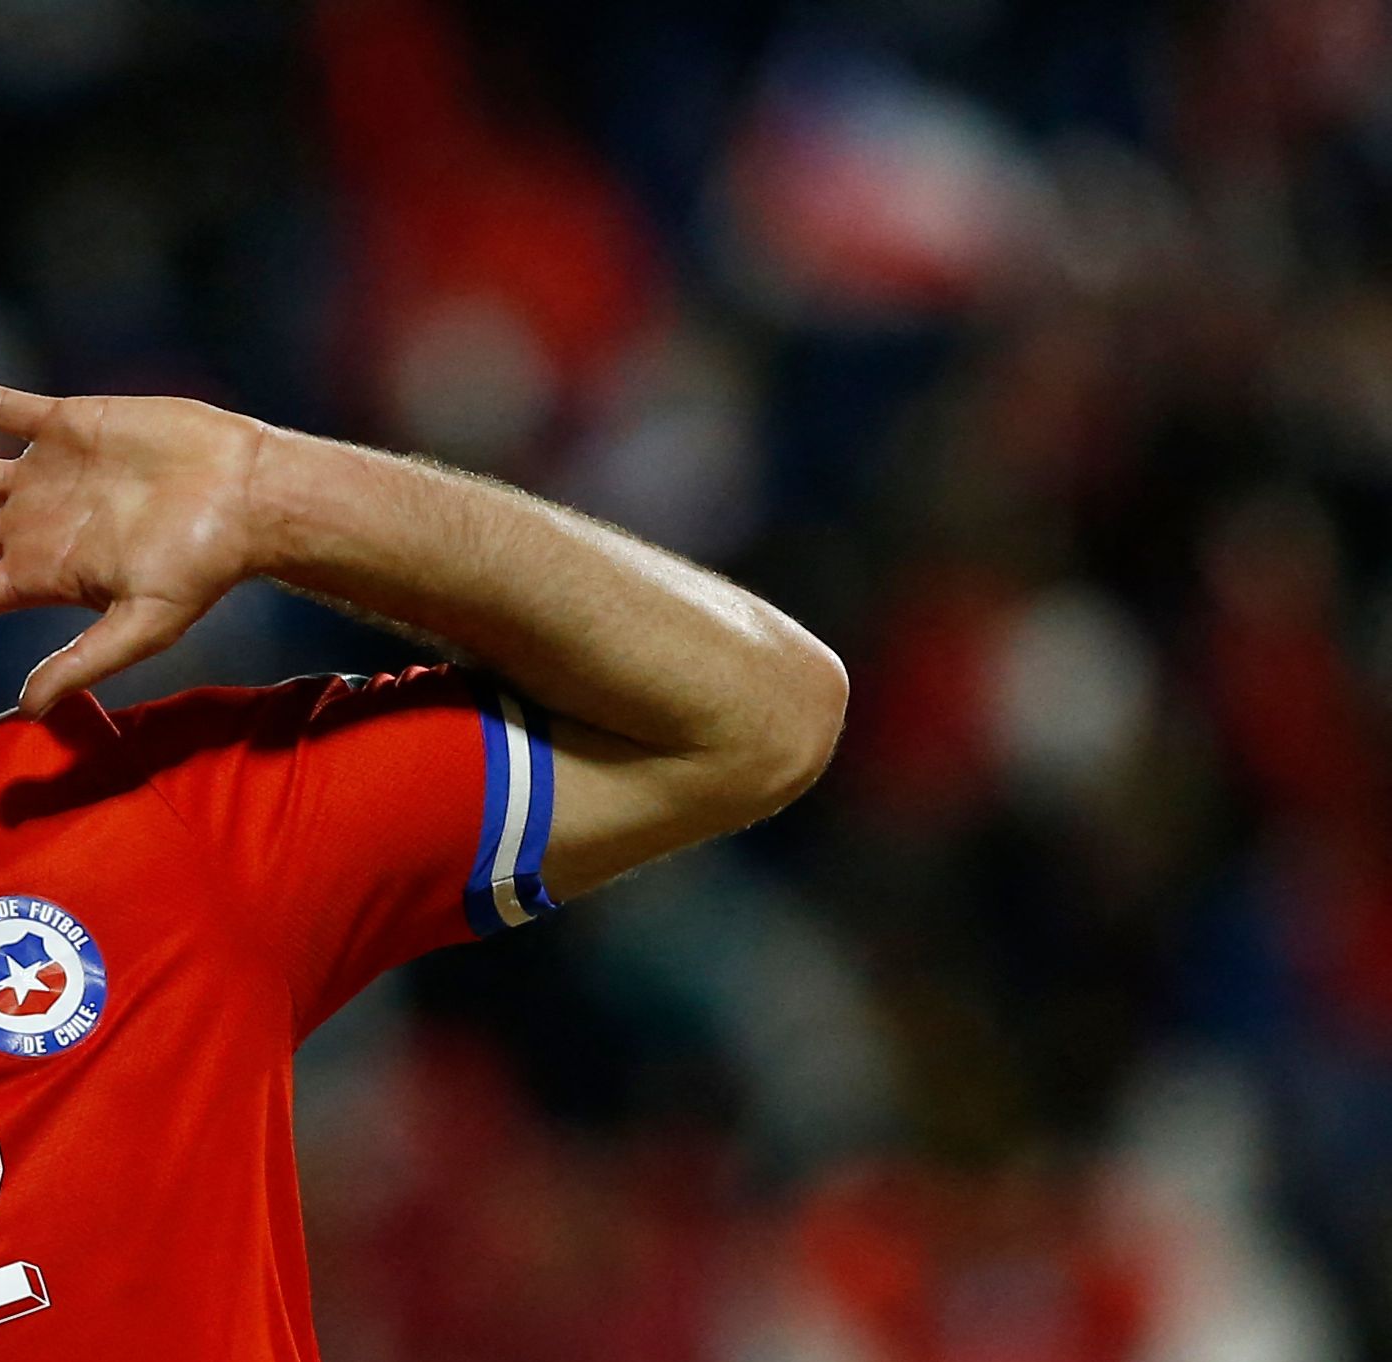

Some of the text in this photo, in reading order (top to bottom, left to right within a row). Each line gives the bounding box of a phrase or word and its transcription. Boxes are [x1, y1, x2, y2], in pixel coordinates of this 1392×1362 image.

[29, 901, 90, 951] FUTBOL
[23, 1005, 98, 1054] DE CHILE
